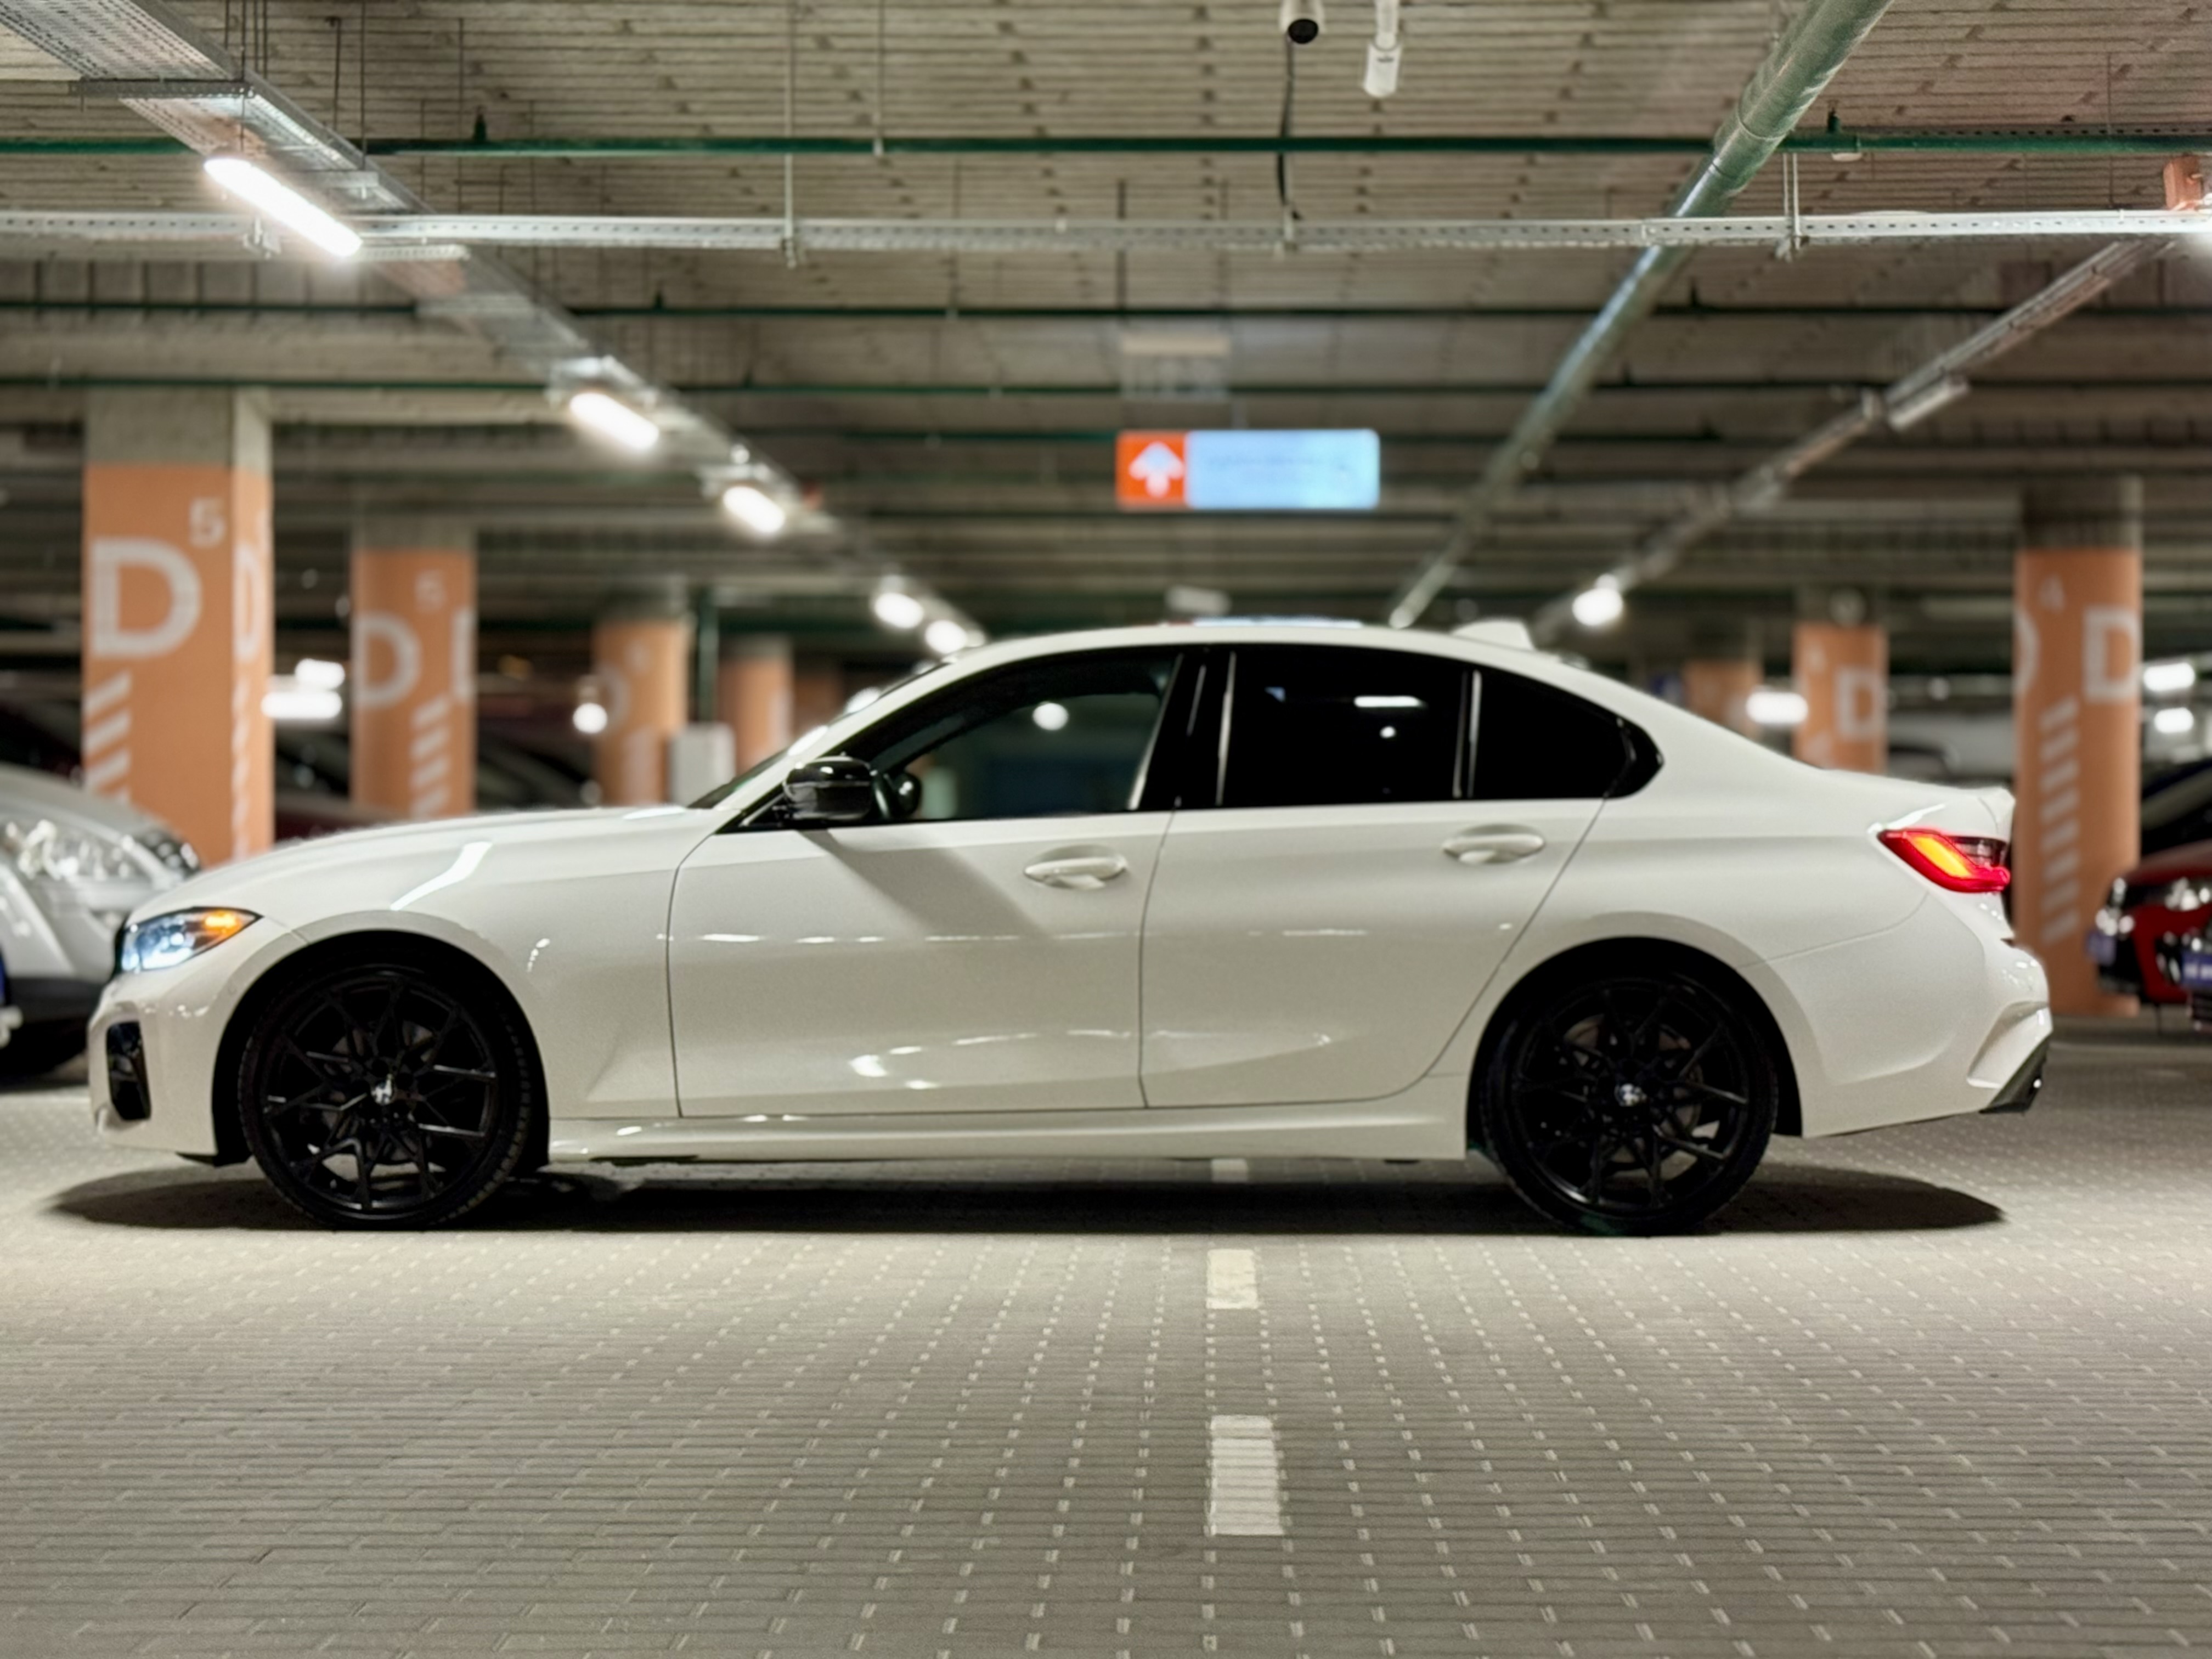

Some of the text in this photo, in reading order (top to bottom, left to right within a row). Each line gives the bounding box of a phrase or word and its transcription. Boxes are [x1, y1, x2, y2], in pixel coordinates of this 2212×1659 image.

[189, 496, 226, 548] 5
[91, 538, 202, 659] D
[354, 611, 421, 709] D
[2083, 605, 2142, 702] D
